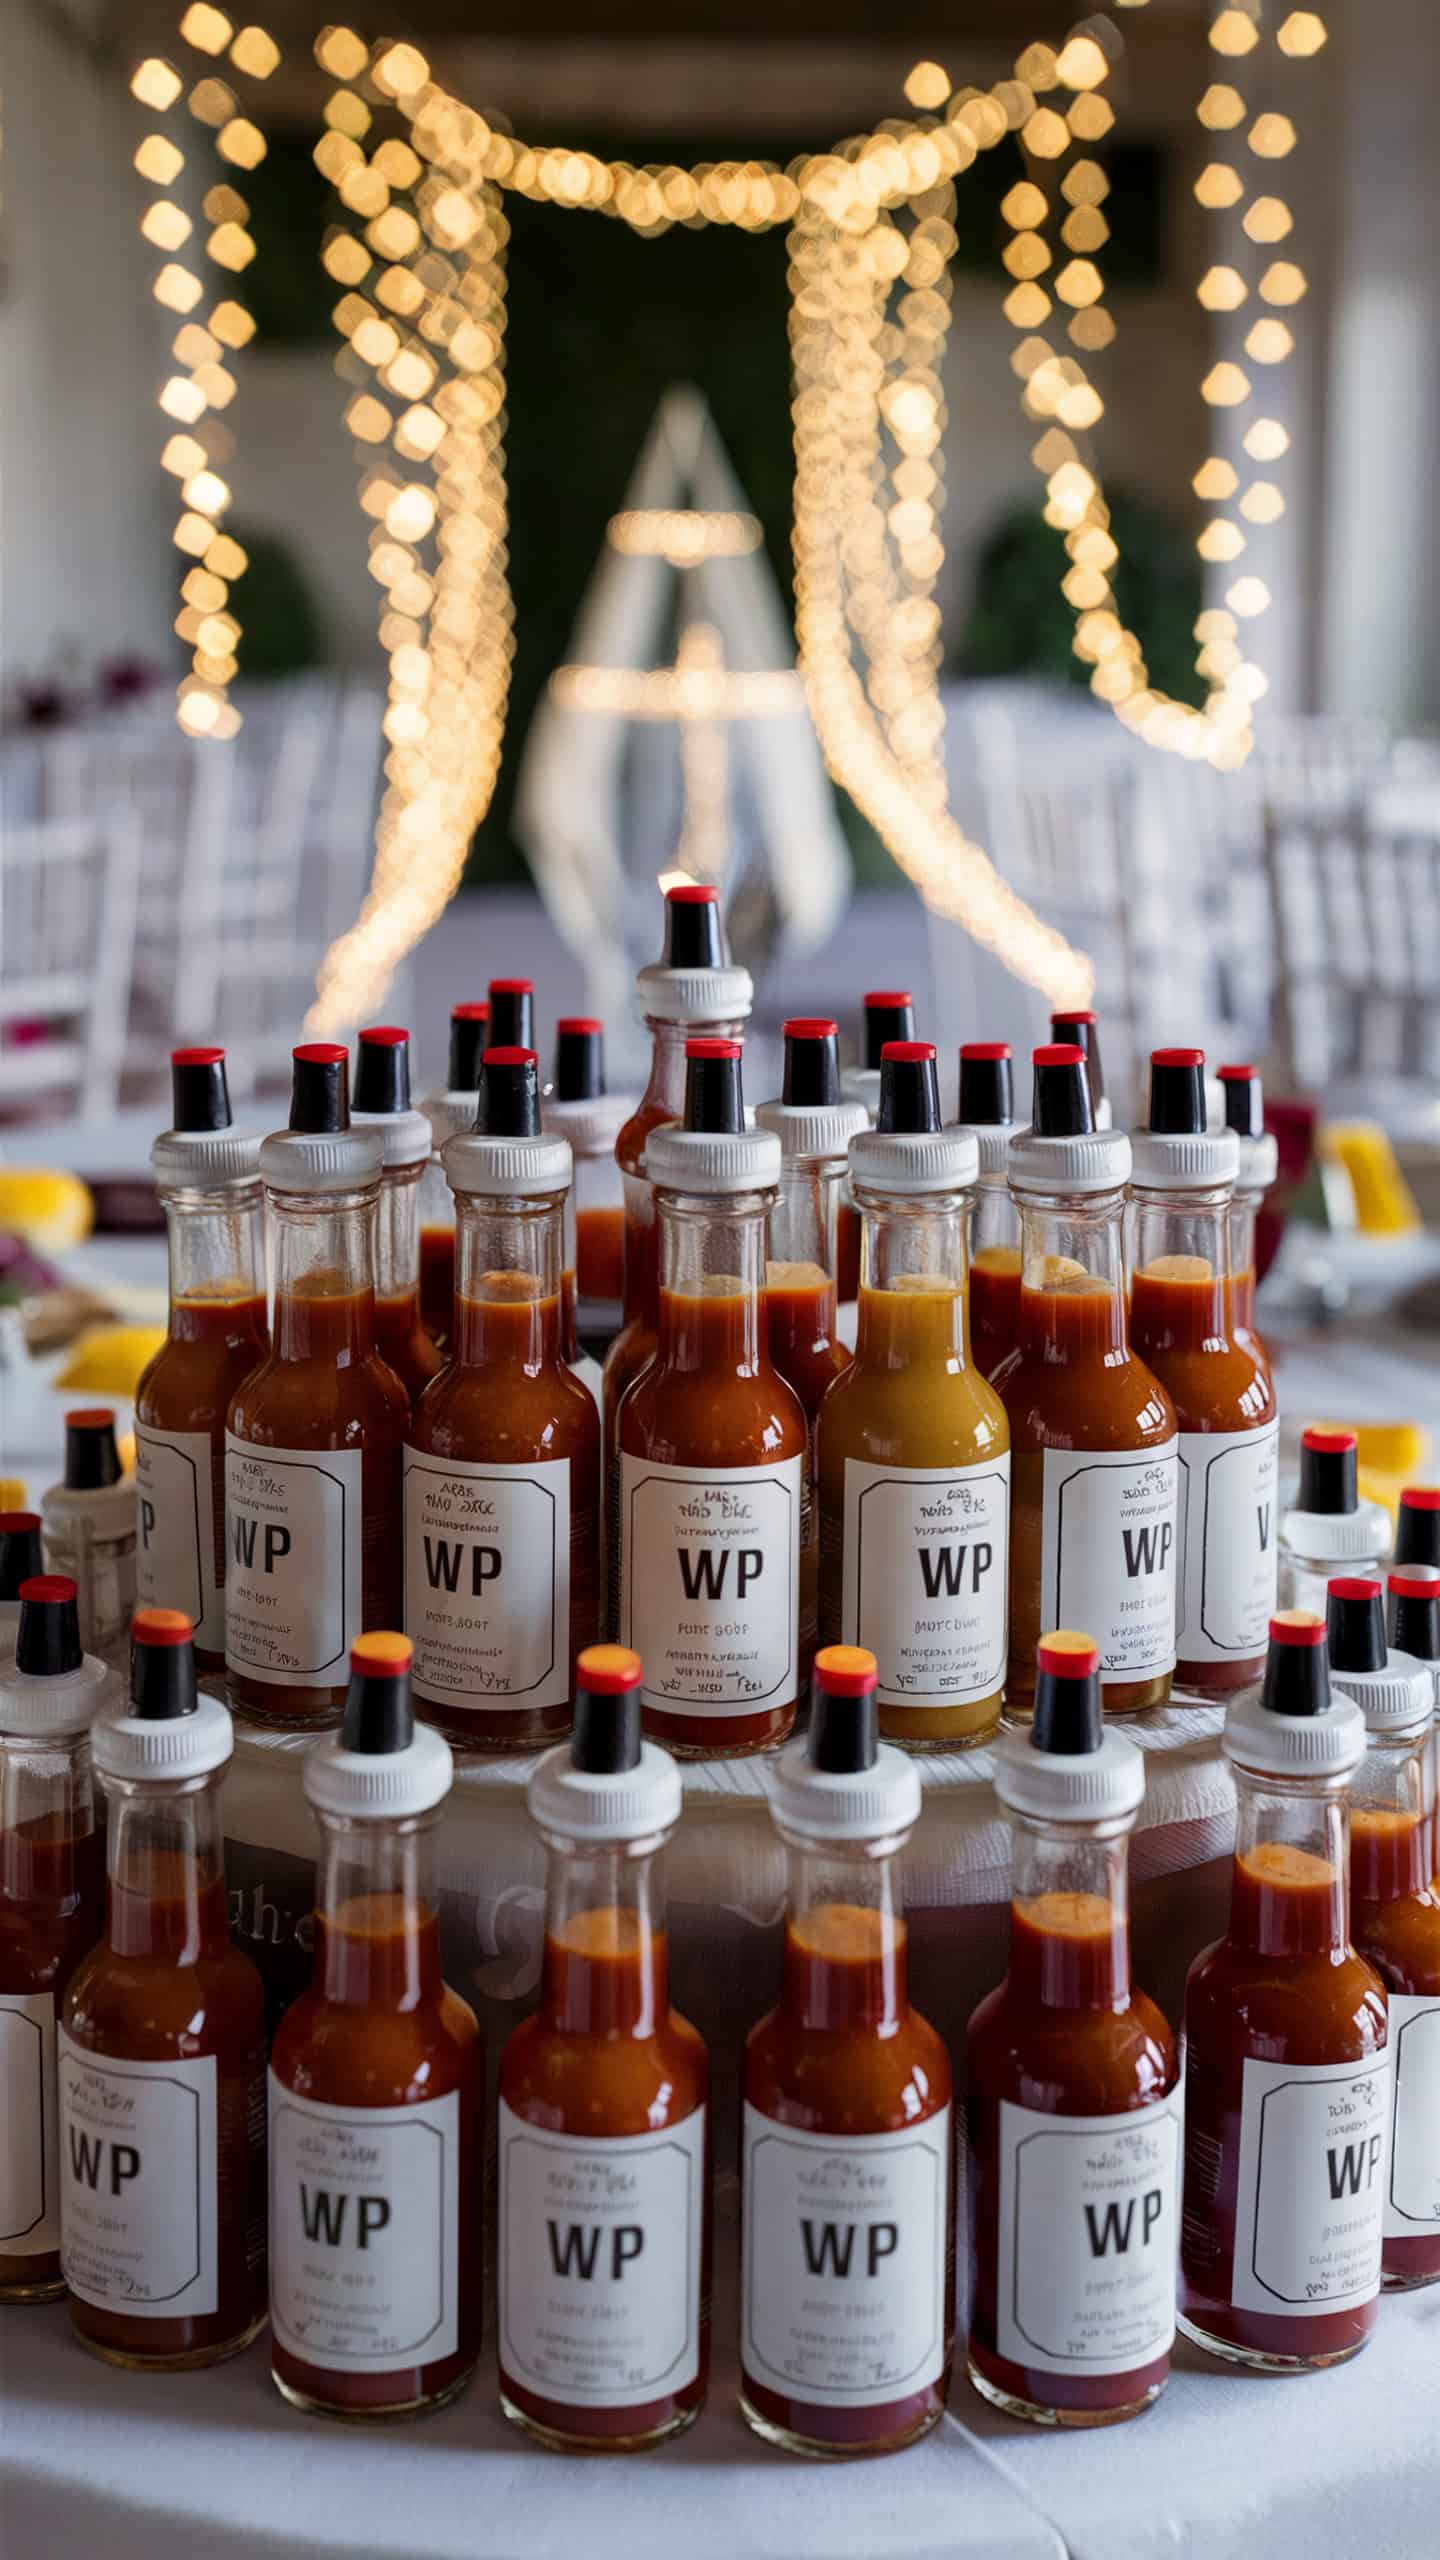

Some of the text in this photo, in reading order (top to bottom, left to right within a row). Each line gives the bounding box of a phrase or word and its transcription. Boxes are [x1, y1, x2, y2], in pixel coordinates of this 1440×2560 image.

[141, 1499, 156, 1550] P
[234, 1516, 291, 1574] WP
[1121, 1521, 1172, 1579] WP
[423, 1535, 502, 1597] WP
[676, 1547, 764, 1600] WP
[916, 1542, 993, 1599] WP
[69, 2124, 141, 2196] WP
[1326, 2134, 1381, 2201] WP
[299, 2182, 391, 2249] WP
[1081, 2192, 1162, 2259] WP
[544, 2215, 644, 2281] WP
[799, 2217, 898, 2280] WP
